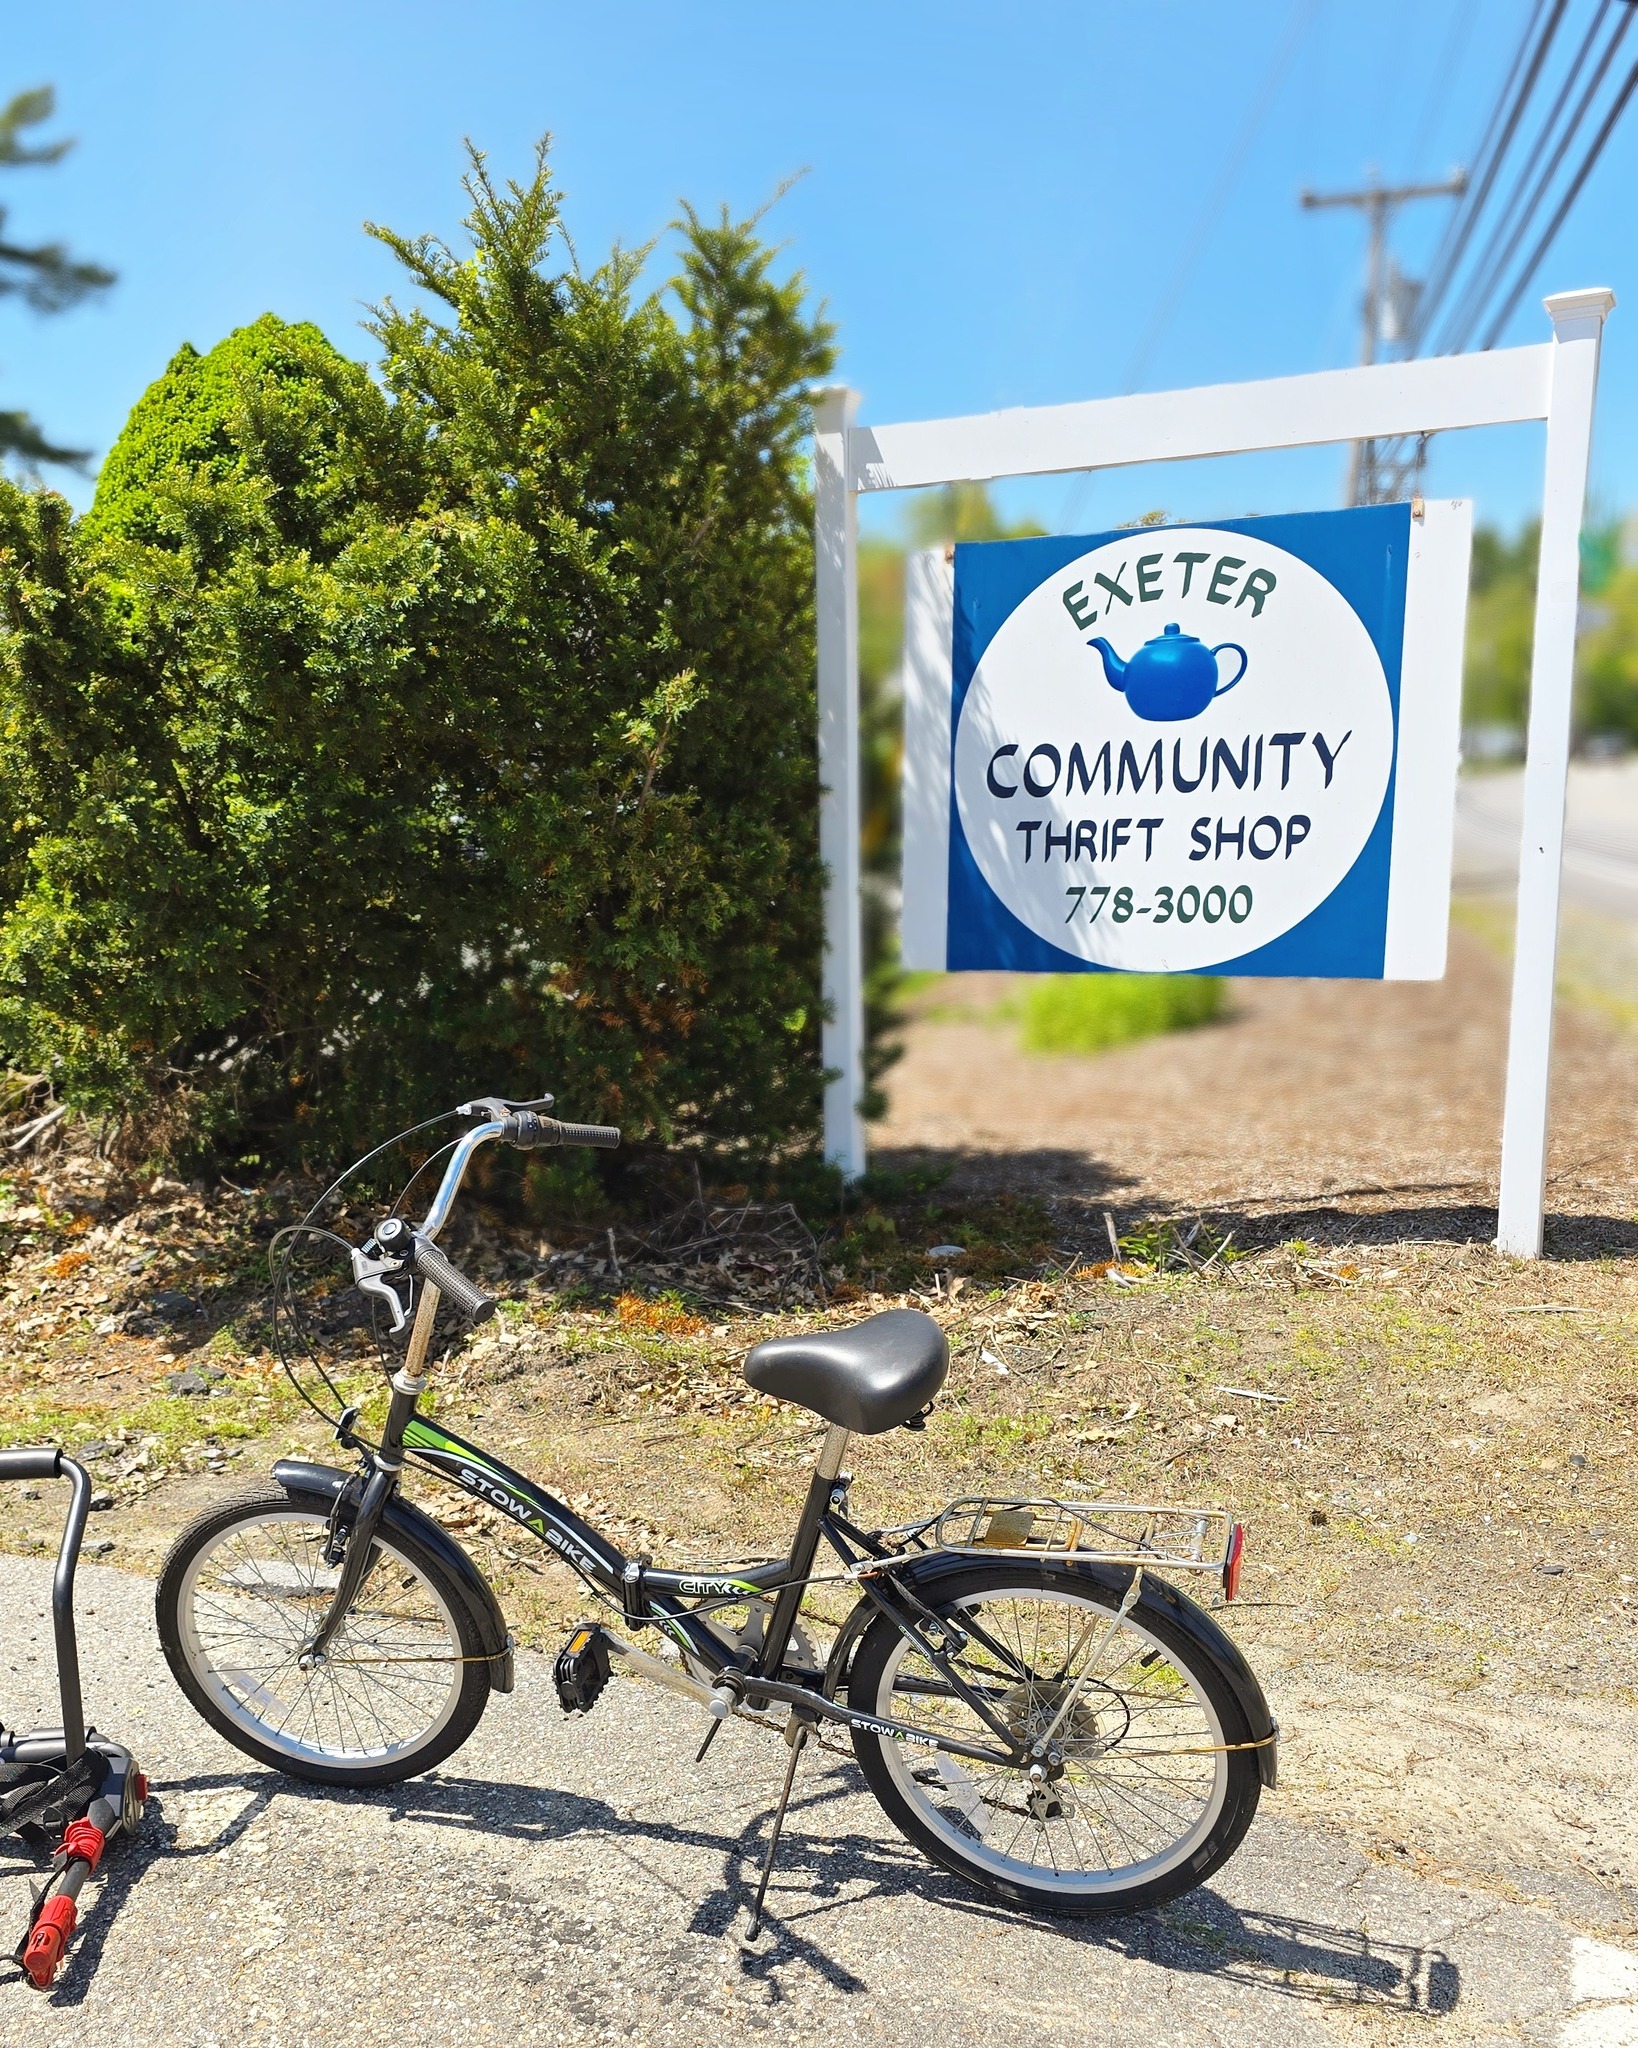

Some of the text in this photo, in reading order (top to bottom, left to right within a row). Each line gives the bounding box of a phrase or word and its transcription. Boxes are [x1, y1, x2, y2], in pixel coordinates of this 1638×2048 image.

[1062, 552, 1277, 631] EXETER
[986, 729, 1353, 799] COMMUNITY
[1015, 814, 1311, 864] THRIFT SHOP
[1064, 884, 1253, 924] 778-3000
[679, 1580, 727, 1594] CITY
